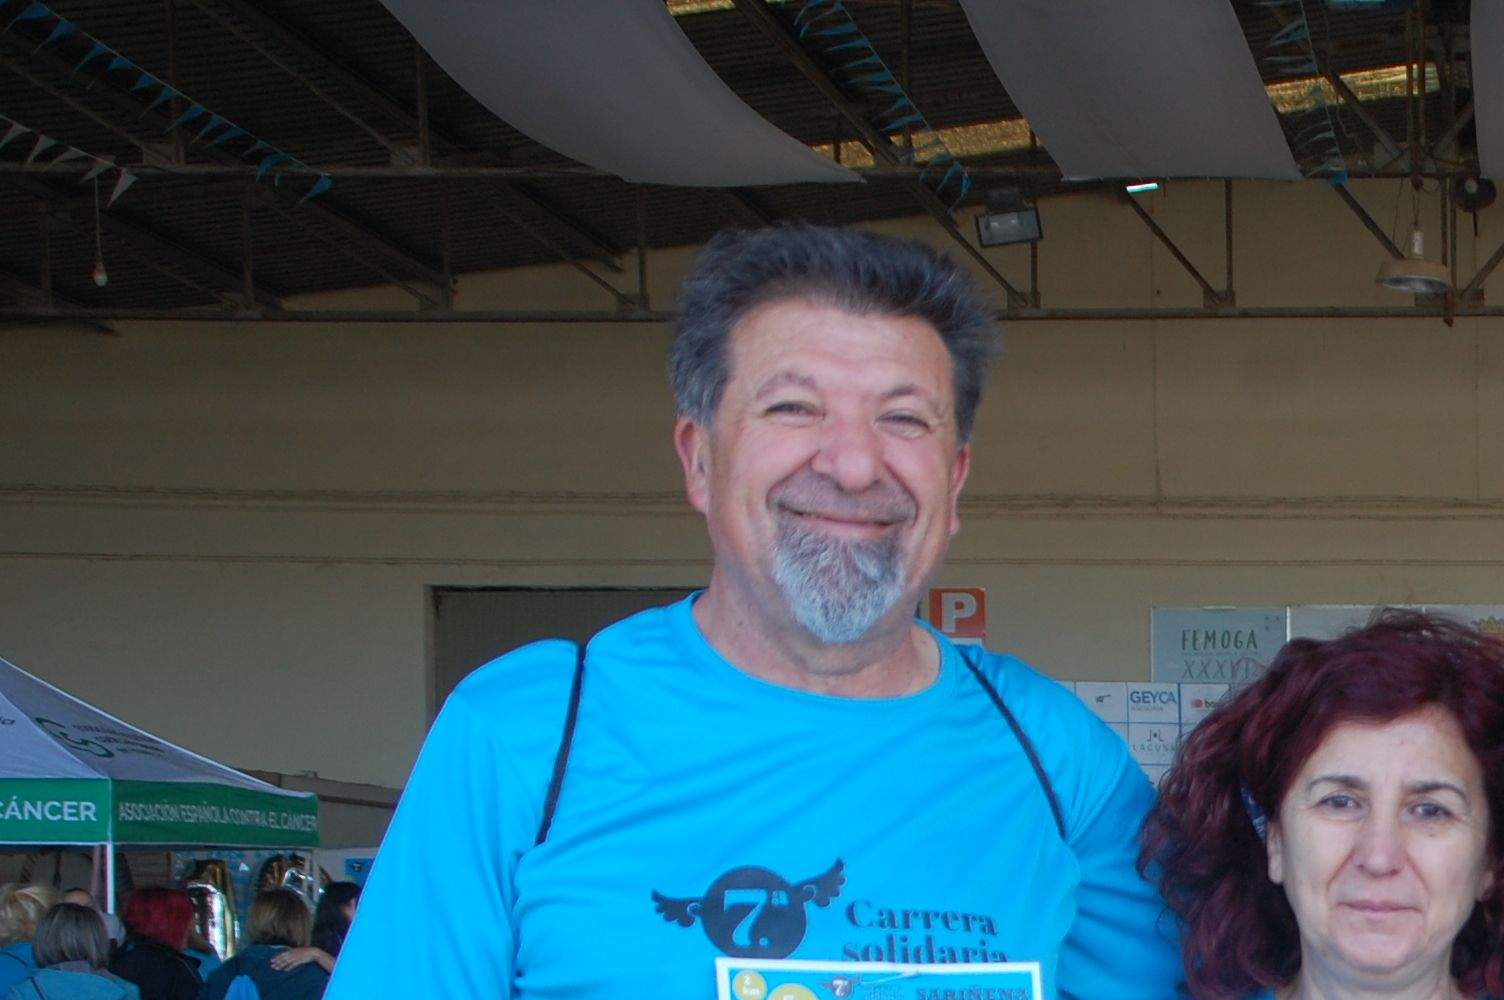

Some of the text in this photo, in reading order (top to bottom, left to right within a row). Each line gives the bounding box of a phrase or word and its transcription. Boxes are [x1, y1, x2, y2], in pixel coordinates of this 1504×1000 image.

[941, 592, 977, 633] P
[1181, 629, 1258, 651] FEMOGA
[1130, 690, 1177, 705] GEYCA
[0, 795, 98, 821] ÁNCER
[118, 800, 317, 832] ASOCIACIÓN ESPAÑOLA CONTRA EL CÁNCER
[845, 900, 998, 937] Carrera
[841, 935, 1008, 964] solidaria
